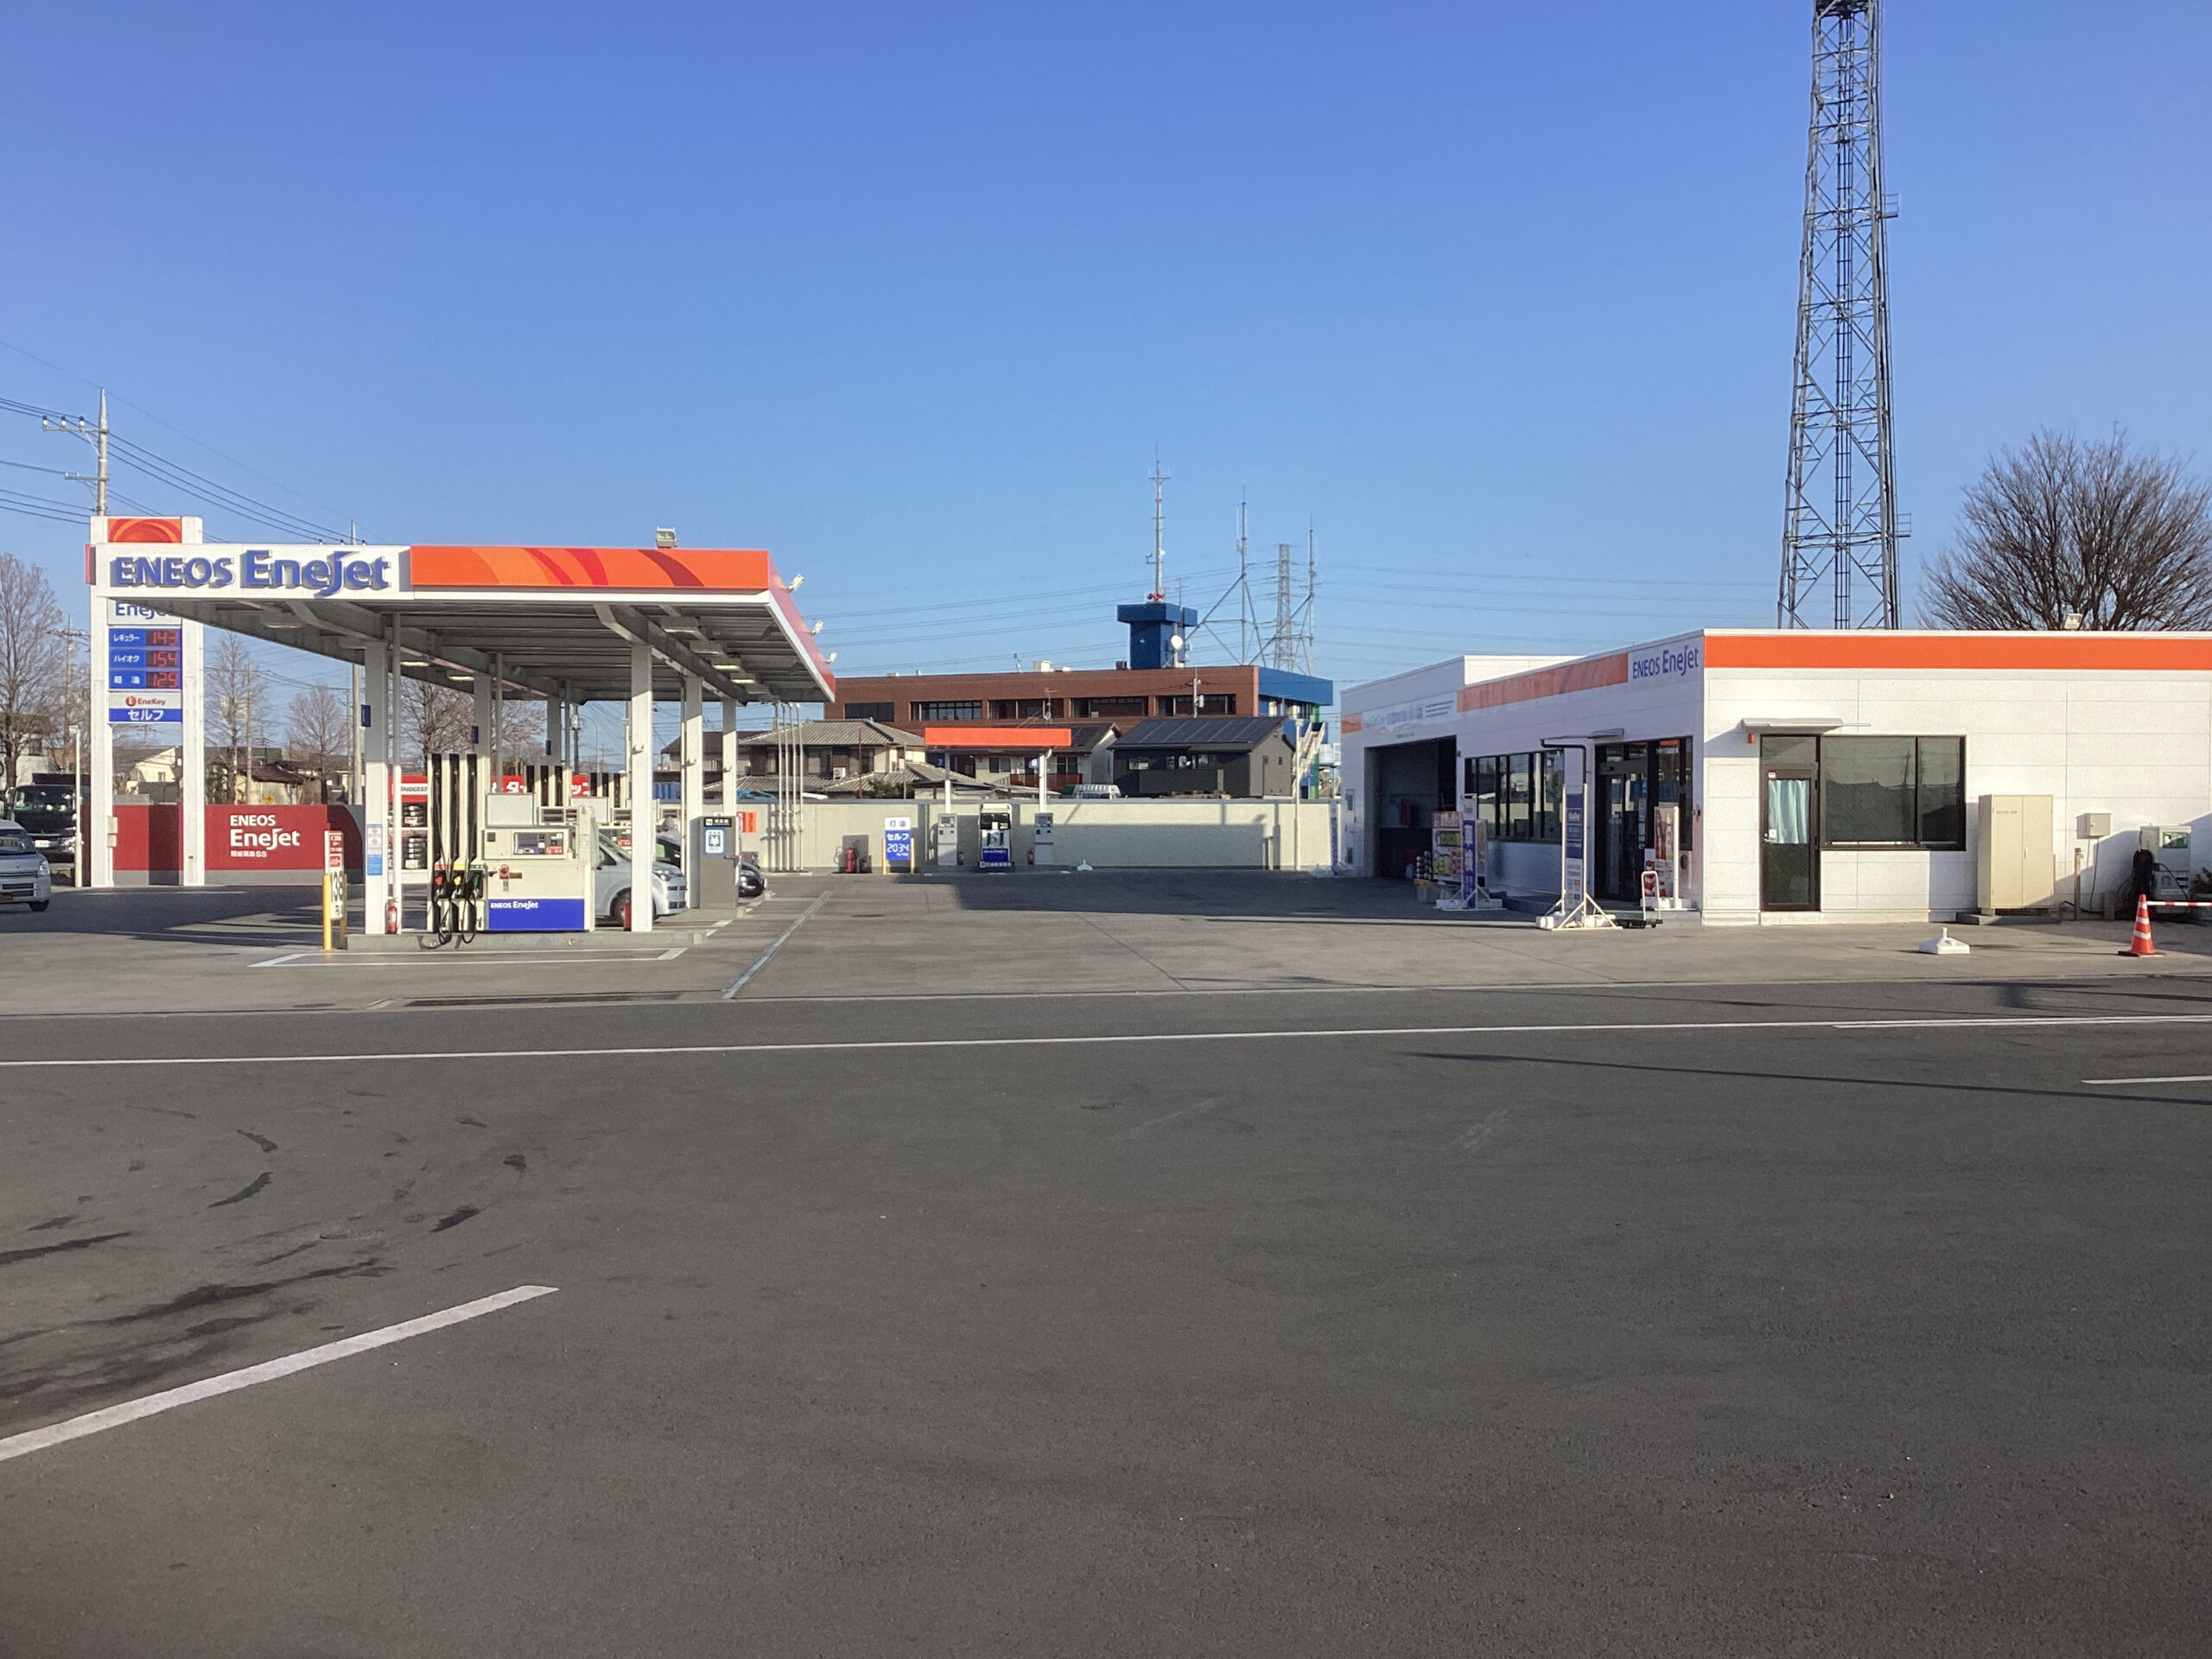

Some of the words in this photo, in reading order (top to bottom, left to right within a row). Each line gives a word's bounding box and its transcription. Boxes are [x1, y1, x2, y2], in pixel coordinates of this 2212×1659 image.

[114, 556, 234, 586] ENEOS
[113, 633, 140, 642] レギュラー
[153, 630, 178, 646] 143
[153, 651, 178, 667] 154
[1632, 656, 1660, 679] ENEOS
[153, 671, 178, 688] 129
[137, 697, 166, 707] EneKey
[127, 709, 164, 721] セルフ
[230, 815, 276, 826] ENEOS
[887, 843, 910, 853] 2034
